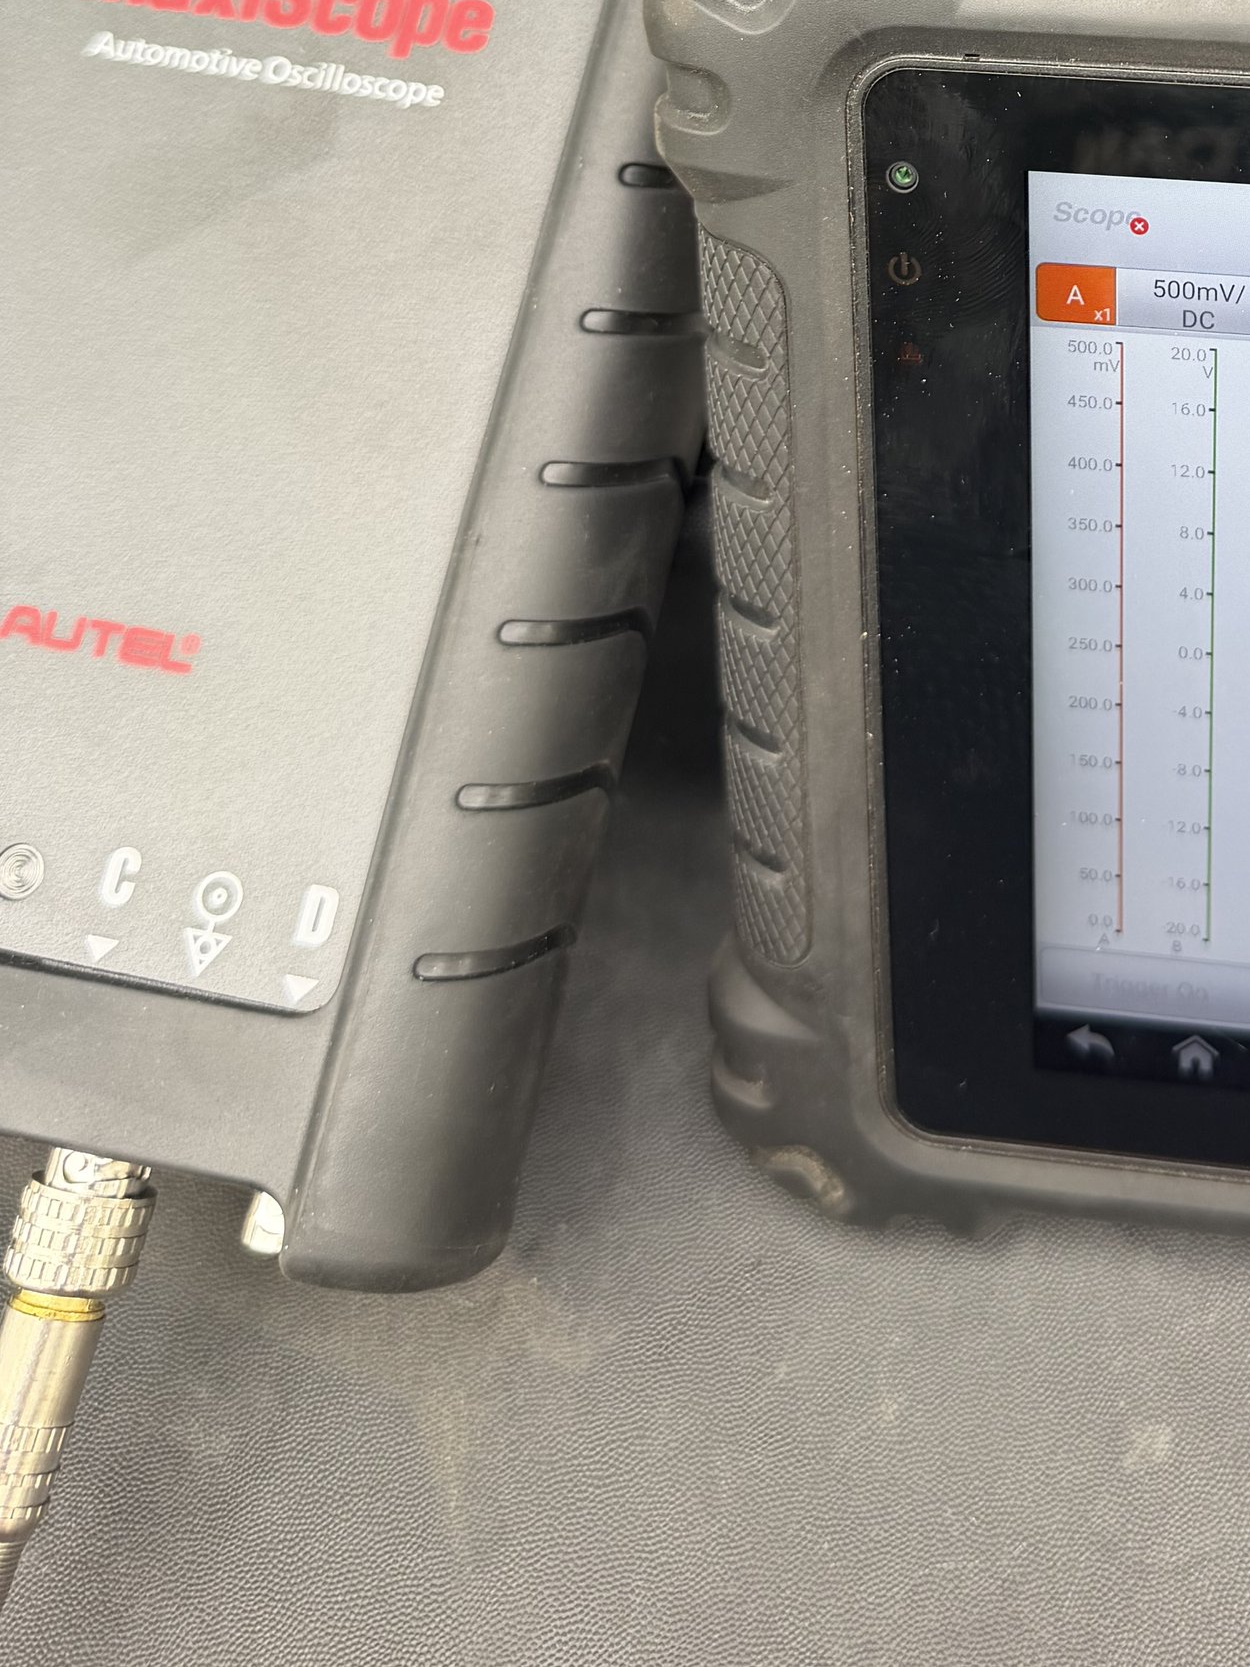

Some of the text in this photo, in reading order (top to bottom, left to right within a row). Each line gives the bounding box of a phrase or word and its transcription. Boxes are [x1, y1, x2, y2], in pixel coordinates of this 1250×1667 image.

[82, 31, 445, 108] Automotive Oscilloscope
[1066, 285, 1085, 306] A
[1153, 279, 1246, 304] 500mV/
[1094, 308, 1111, 322] x1
[1182, 310, 1216, 330] DC
[1068, 340, 1113, 355] 500.0
[1171, 346, 1207, 362] 20.0
[1093, 359, 1120, 372] mV
[1202, 366, 1213, 379] V
[1068, 394, 1113, 410] 450.0
[1172, 402, 1206, 417] 16.0
[1068, 456, 1113, 472] 400.0
[1171, 464, 1206, 479] 12.0
[1068, 517, 1113, 533] 350.0
[1179, 526, 1204, 540] 8.0
[1068, 577, 1113, 592] 300.0
[1179, 587, 1204, 601] 4.0
[1068, 637, 1113, 652] 250.0
[1178, 646, 1203, 660] 0.0
[1068, 695, 1113, 711] 200.0
[1070, 754, 1113, 769] 150.0
[1070, 811, 1113, 826] 100.0
[101, 846, 142, 908] C
[1080, 867, 1112, 882] 50.0
[295, 884, 340, 945] D
[1088, 914, 1112, 927] 0.0
[1099, 934, 1110, 945] A
[1172, 940, 1182, 952] B
